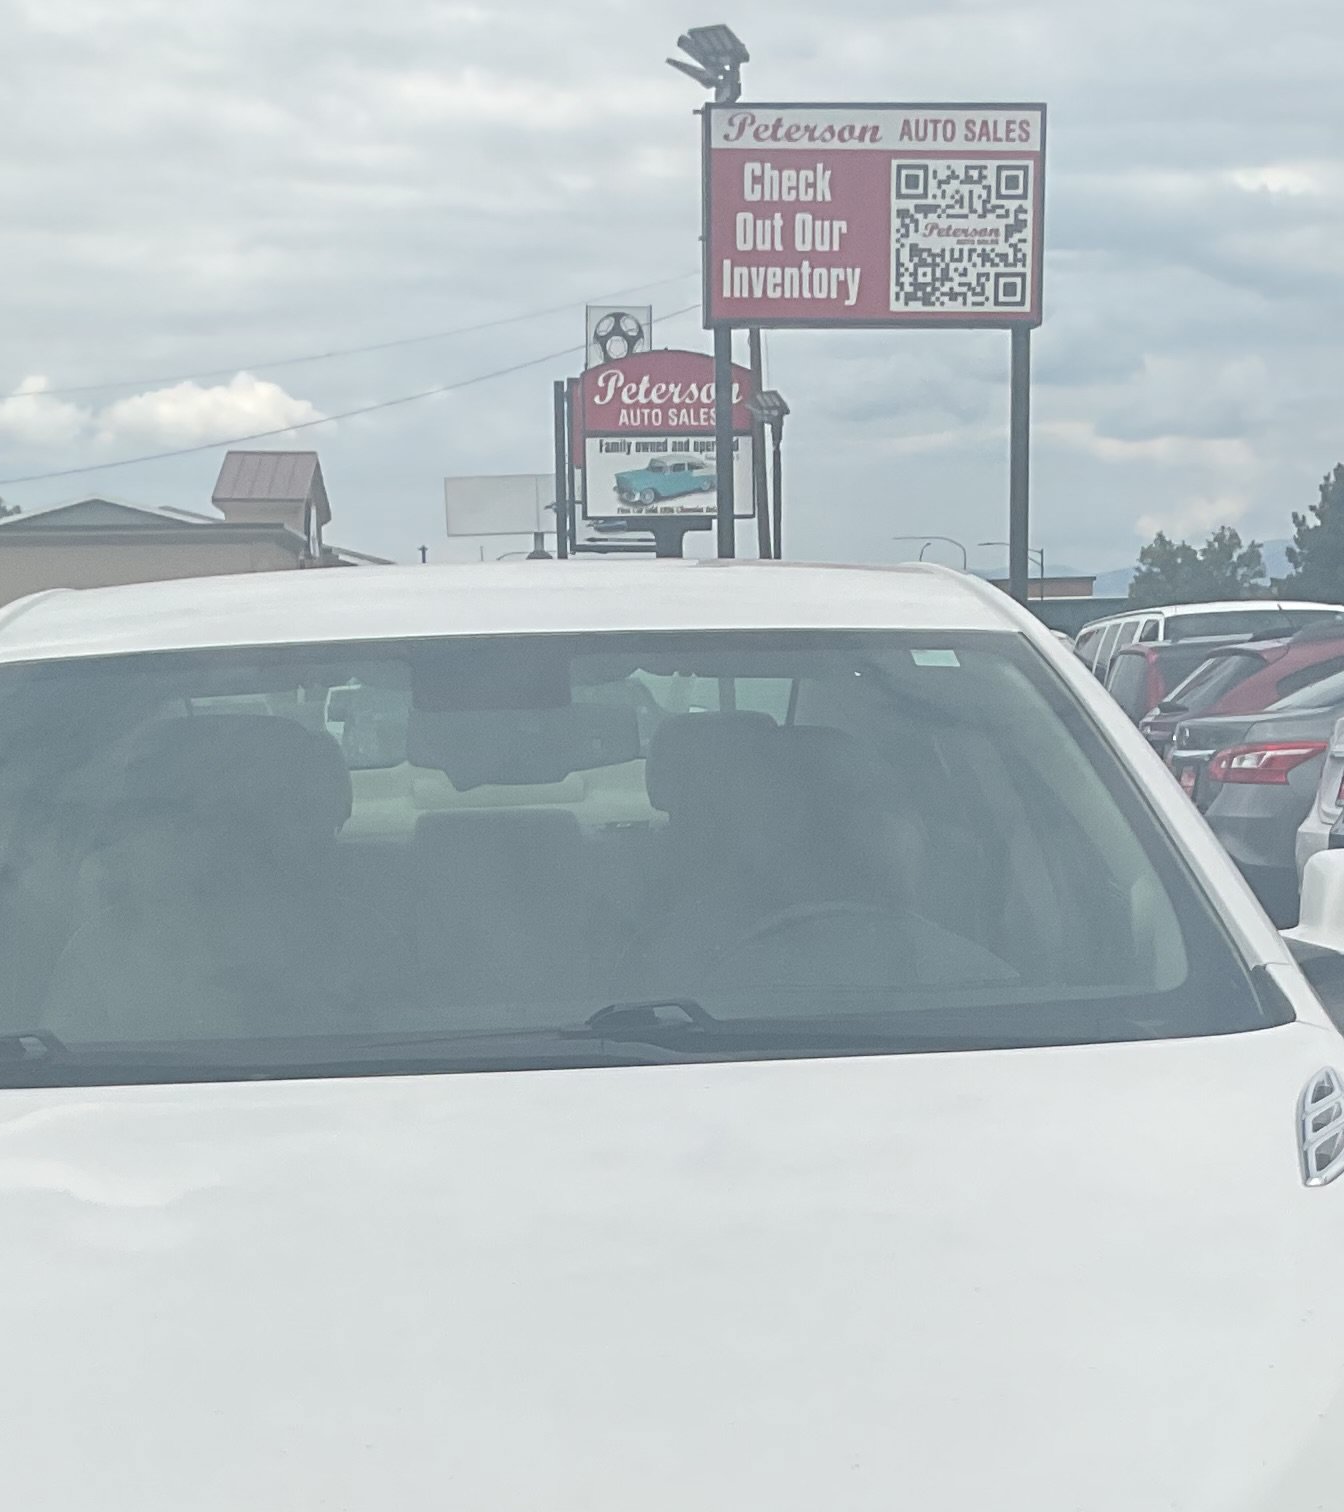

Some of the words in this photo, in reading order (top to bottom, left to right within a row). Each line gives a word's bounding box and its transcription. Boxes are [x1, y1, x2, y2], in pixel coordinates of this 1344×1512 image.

[722, 112, 882, 144] Peterson
[899, 119, 956, 143] AUTO
[964, 119, 1031, 143] SALES
[743, 161, 832, 202] Check
[735, 212, 784, 251] Out
[794, 212, 848, 251] Our
[722, 259, 861, 306] Inventory
[618, 408, 663, 426] AUTO
